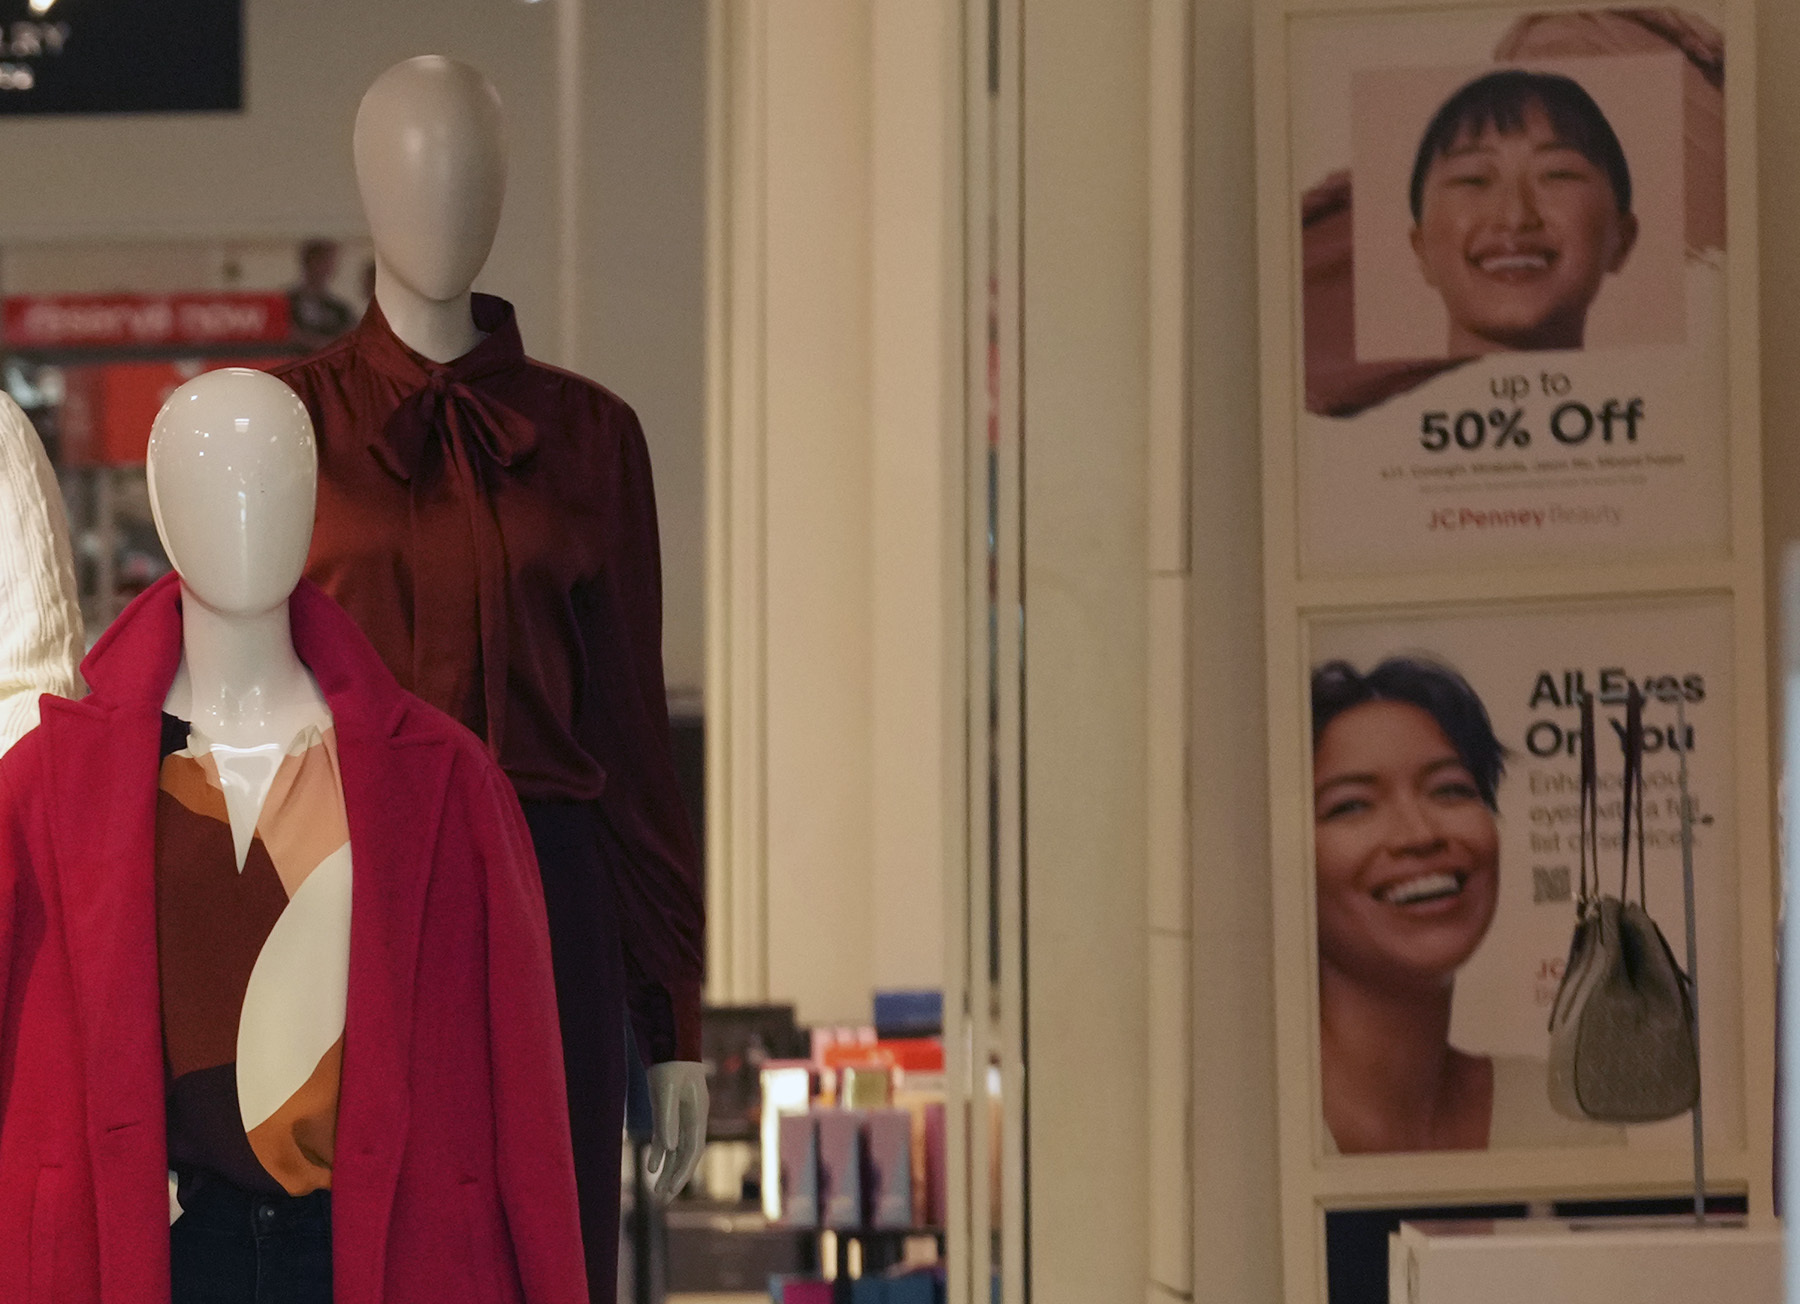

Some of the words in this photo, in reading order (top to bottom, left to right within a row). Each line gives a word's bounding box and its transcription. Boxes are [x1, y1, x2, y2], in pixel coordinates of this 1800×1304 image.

[1489, 374, 1530, 402] up
[1540, 371, 1572, 397] to
[1420, 408, 1531, 451] 50%
[1550, 397, 1645, 445] Off
[1529, 668, 1583, 709] All
